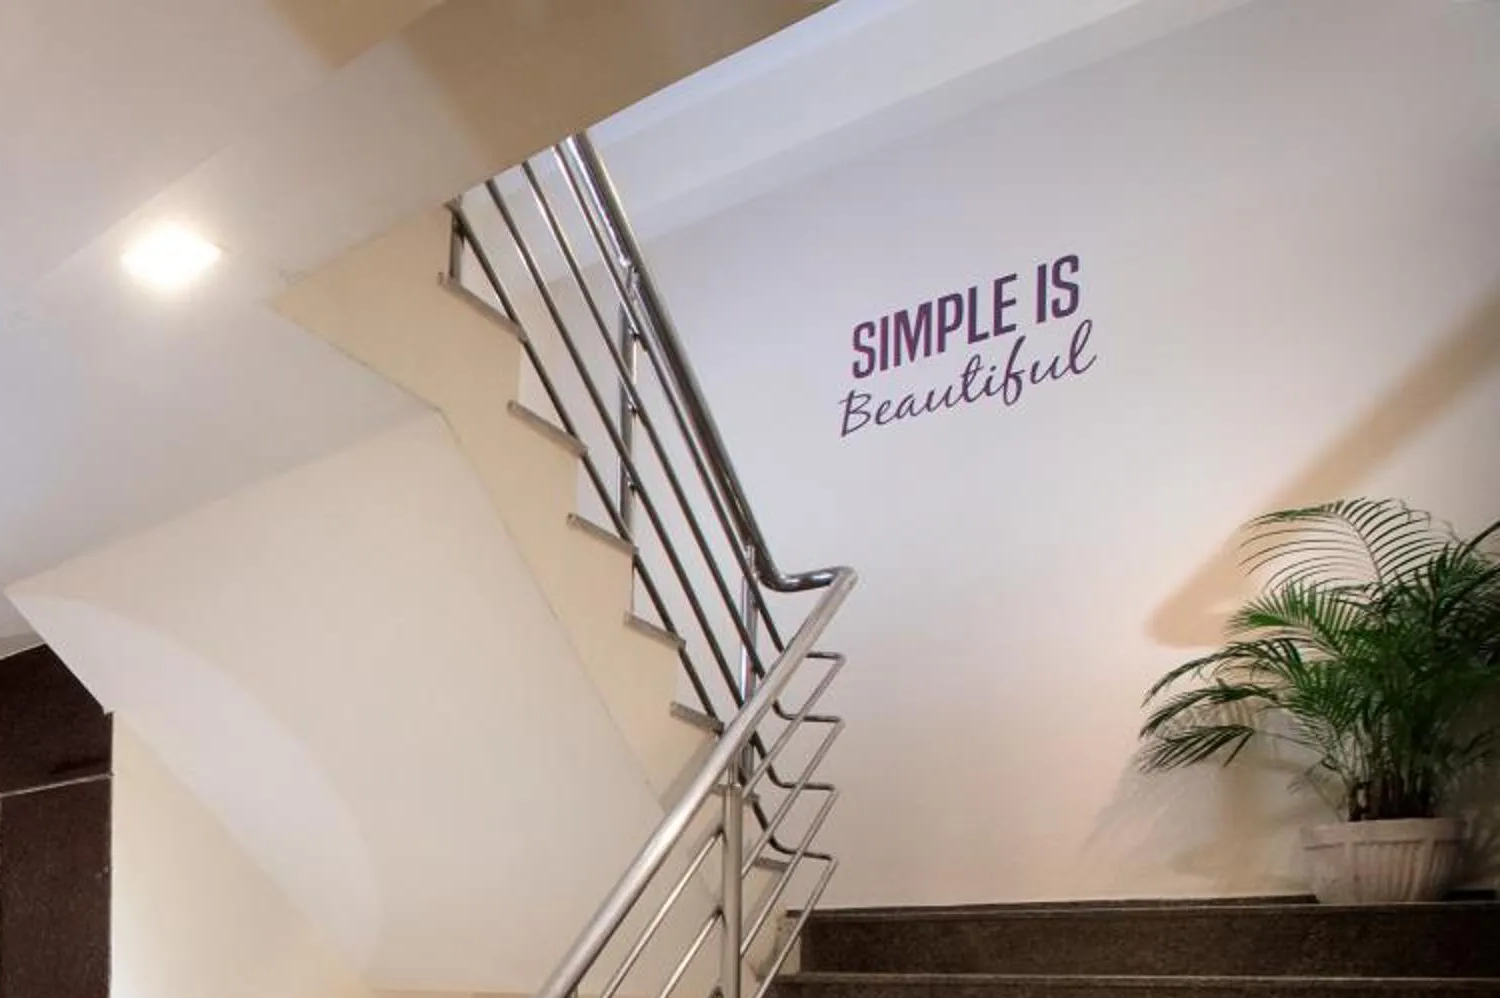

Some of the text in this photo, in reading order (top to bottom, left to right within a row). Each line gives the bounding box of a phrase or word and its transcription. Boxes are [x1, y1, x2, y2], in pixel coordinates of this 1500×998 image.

[837, 318, 1098, 438] Beautiful
[851, 254, 1080, 380] SIMPLE IS
